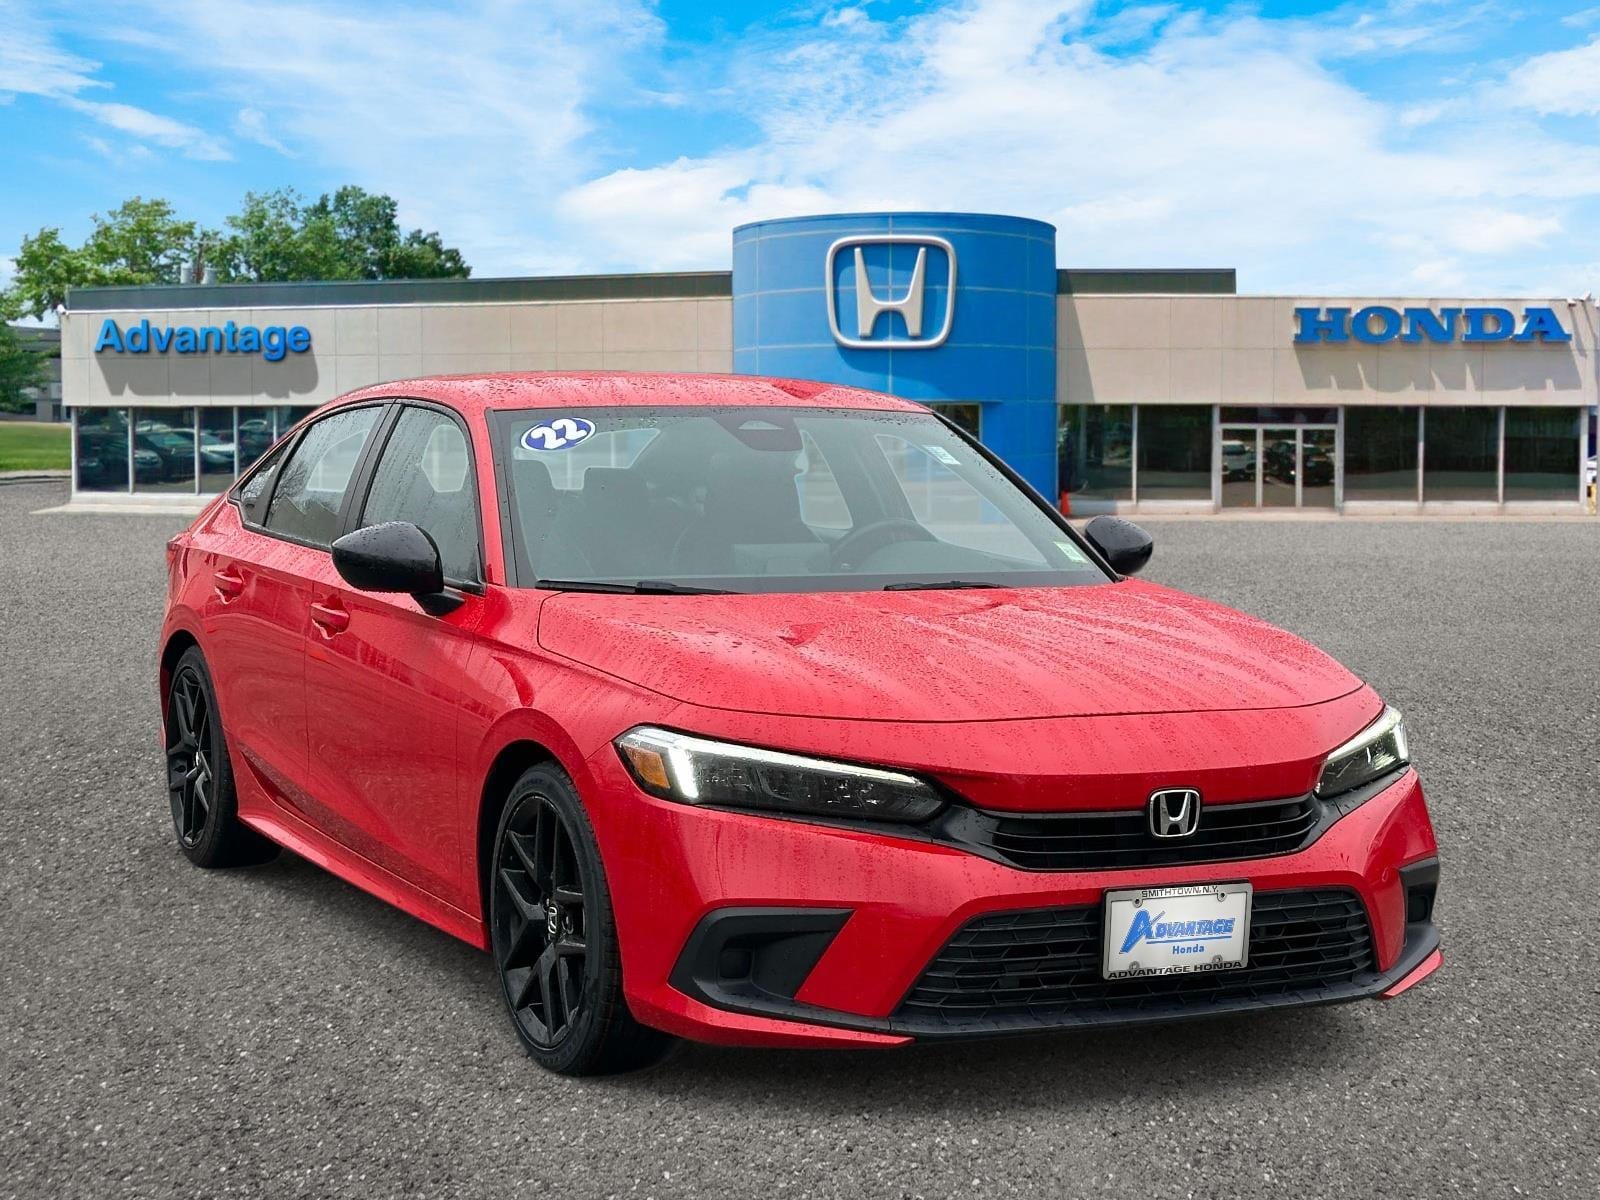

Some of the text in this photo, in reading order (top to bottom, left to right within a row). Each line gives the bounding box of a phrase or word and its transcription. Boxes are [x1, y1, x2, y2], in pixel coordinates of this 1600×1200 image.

[95, 319, 311, 362] Advantage
[1294, 306, 1572, 343] HONDA
[530, 418, 588, 450] 22
[1119, 909, 1236, 954] ADVANTAGE
[1172, 944, 1205, 955] Honda
[1108, 961, 1242, 979] ADVANTAGE HONDA
